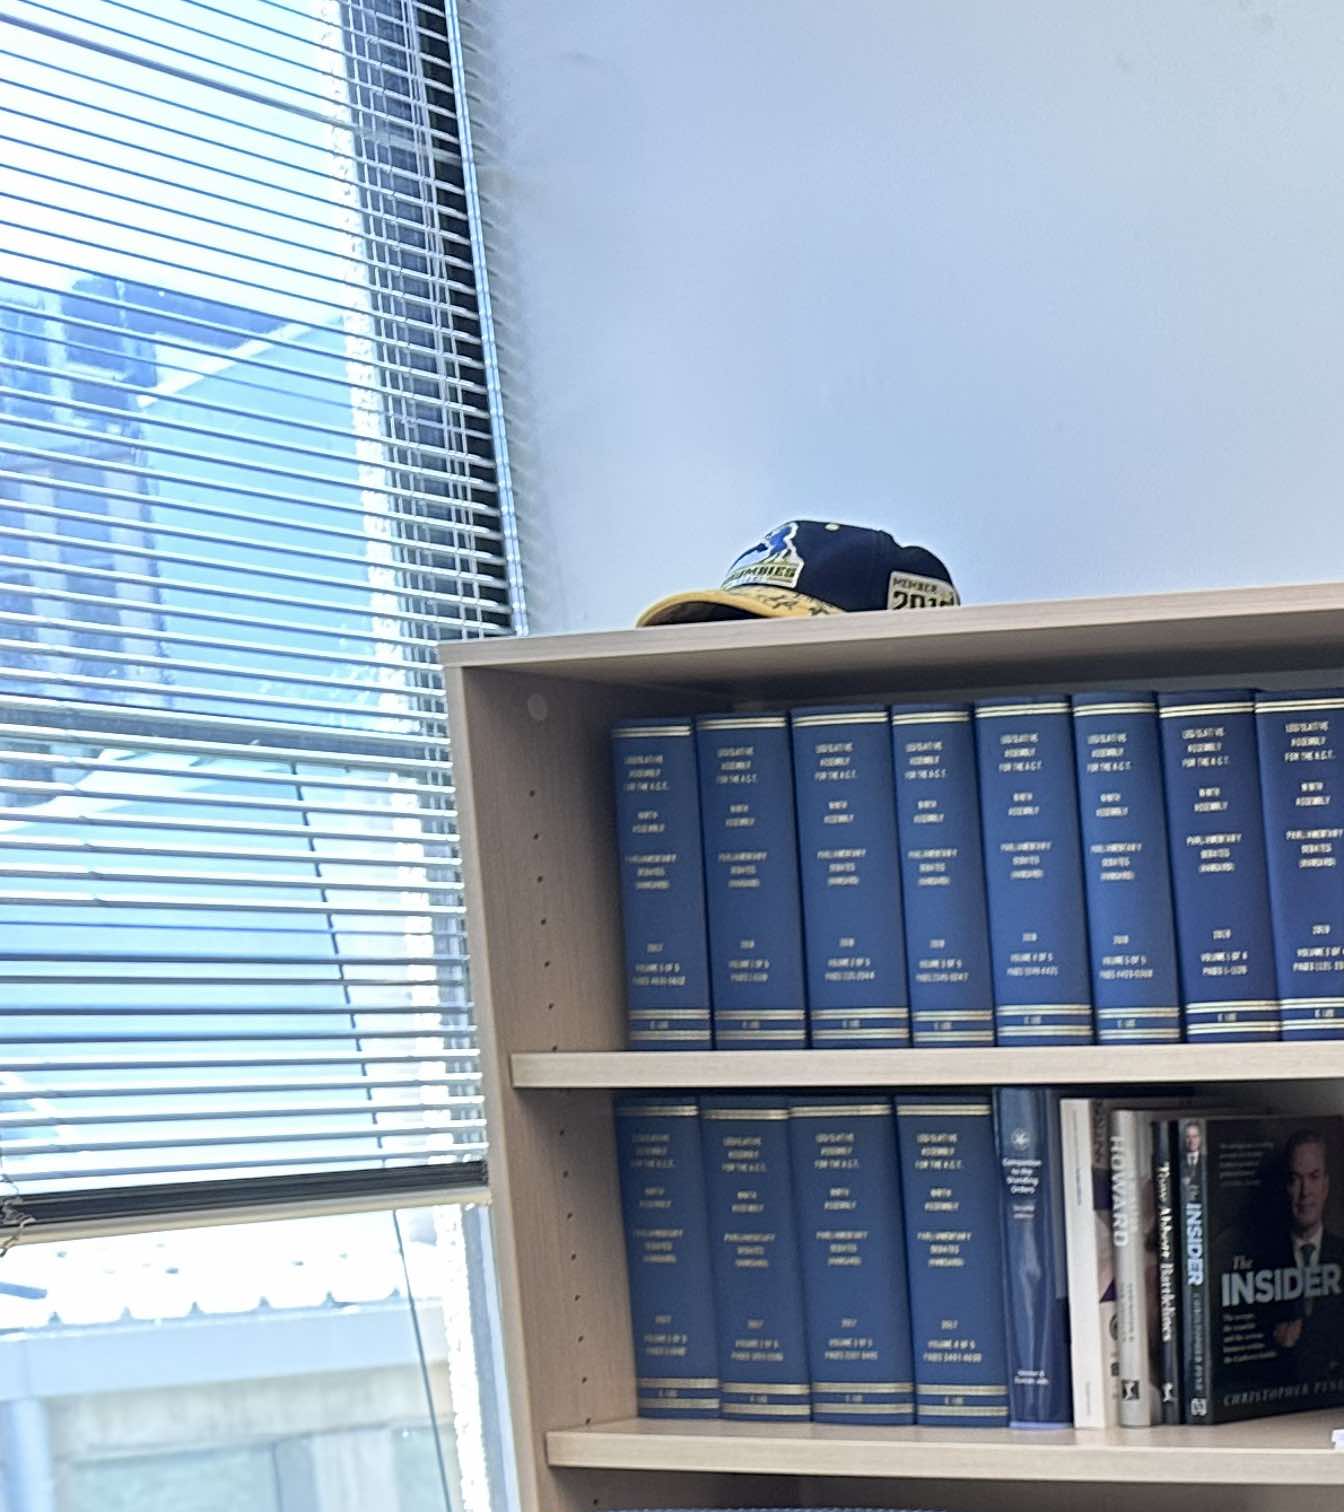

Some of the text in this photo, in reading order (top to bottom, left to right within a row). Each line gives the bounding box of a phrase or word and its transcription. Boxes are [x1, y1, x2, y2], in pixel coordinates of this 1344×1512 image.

[893, 577, 937, 592] MEMBER
[1110, 1135, 1129, 1247] HOWARD
[1186, 1203, 1203, 1286] INSIDER
[1221, 1263, 1342, 1307] INSIDER
